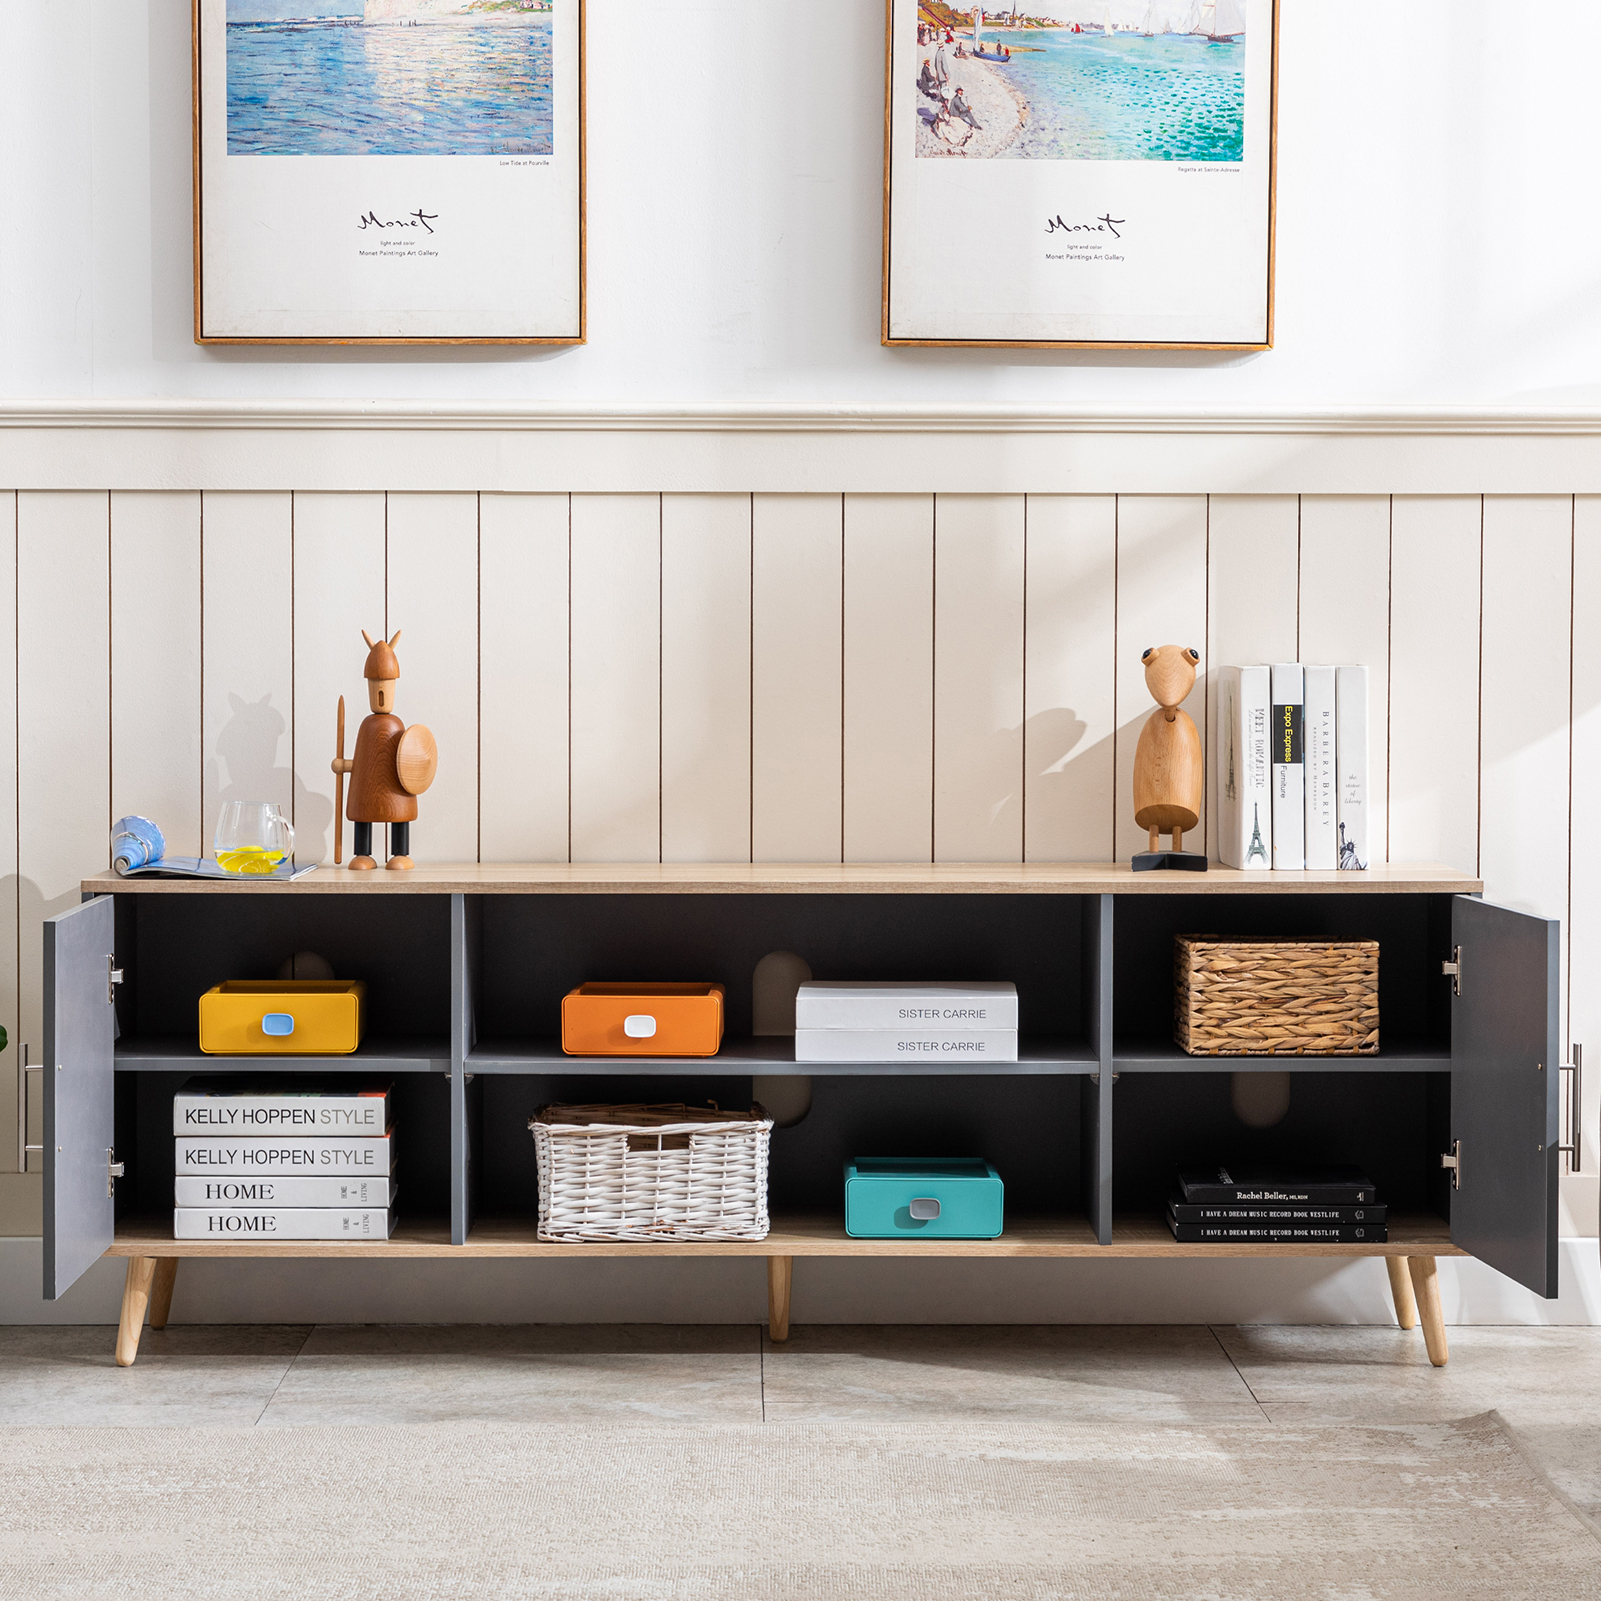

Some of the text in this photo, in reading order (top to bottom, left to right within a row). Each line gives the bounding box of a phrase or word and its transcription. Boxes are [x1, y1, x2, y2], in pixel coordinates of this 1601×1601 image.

[357, 208, 438, 234] Monet
[1044, 213, 1126, 239] Monet
[1284, 706, 1292, 762] Expo Express
[1255, 708, 1265, 788] MEET ROMANTIC
[898, 1009, 986, 1018] SISTER CARRIE
[897, 1042, 985, 1051] SISTER CARRIE
[185, 1109, 375, 1124] KELLY HOPPEN STYLE
[185, 1149, 374, 1164] KELLY HOPPEN STYLE
[205, 1184, 274, 1200] HOME
[1264, 1192, 1288, 1200] Beller,
[207, 1216, 277, 1231] HOME
